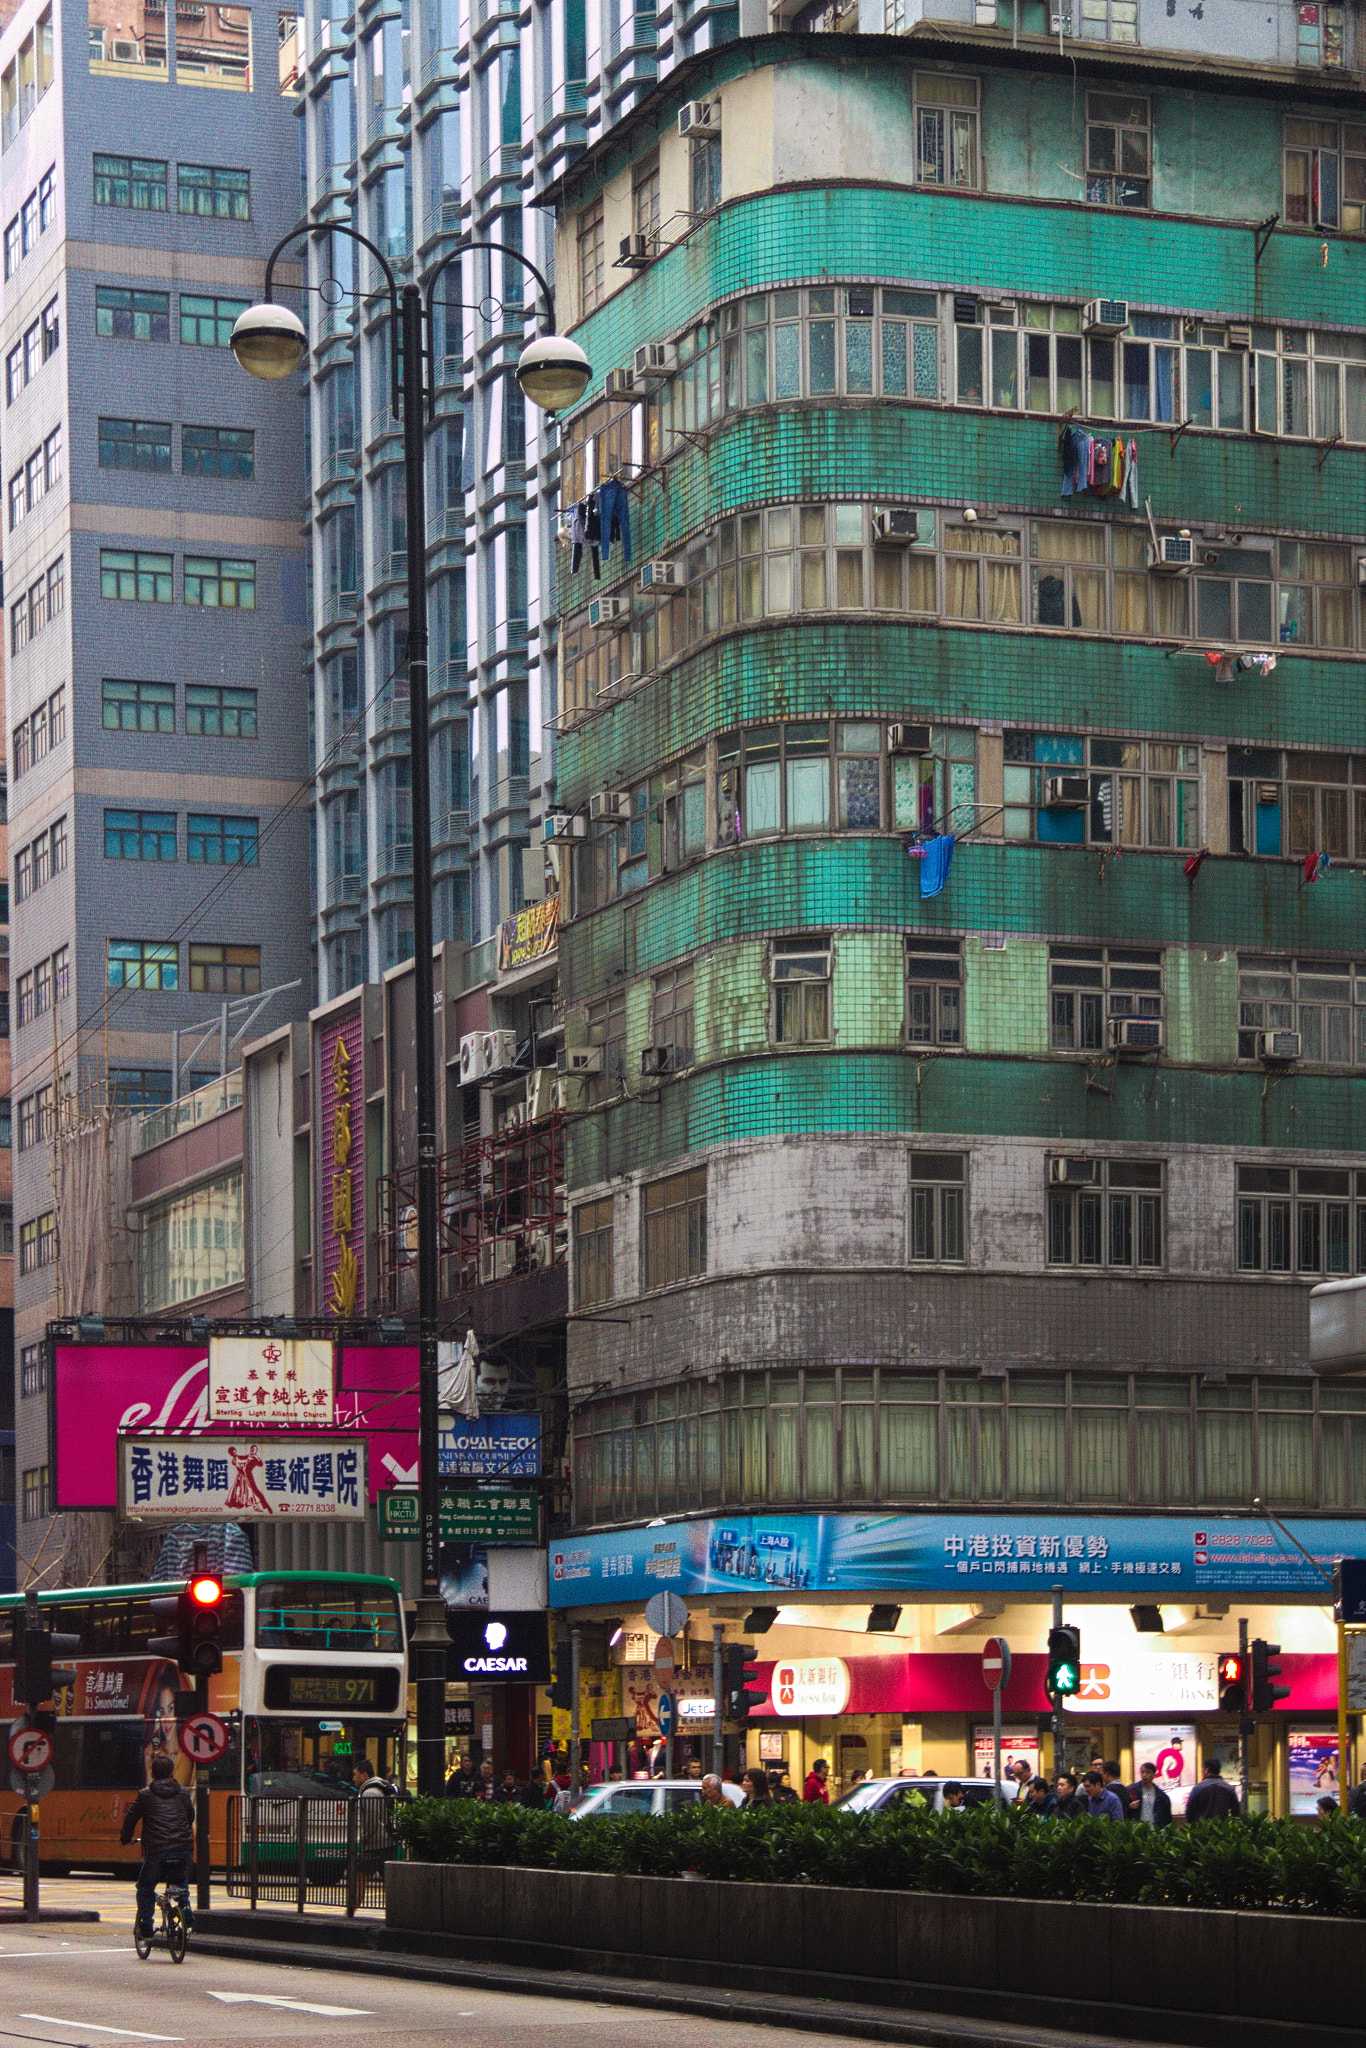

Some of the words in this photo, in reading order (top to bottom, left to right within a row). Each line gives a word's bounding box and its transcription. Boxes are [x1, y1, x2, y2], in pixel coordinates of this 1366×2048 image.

[248, 1369, 296, 1381] 基督教
[216, 1386, 328, 1405] 宣道會純光堂
[216, 1409, 242, 1417] Sterling
[248, 1409, 266, 1418] Light
[271, 1410, 298, 1418] Alliance
[316, 1504, 336, 1513] 8338
[390, 1510, 415, 1518] HKCTU
[943, 1534, 1109, 1559] 中港投資新優勢
[1211, 1534, 1241, 1546] 2828
[1244, 1534, 1273, 1546] 7028
[464, 1657, 528, 1672] CAESAR
[798, 1667, 838, 1686] 大新銀行
[345, 1679, 374, 1701] 971
